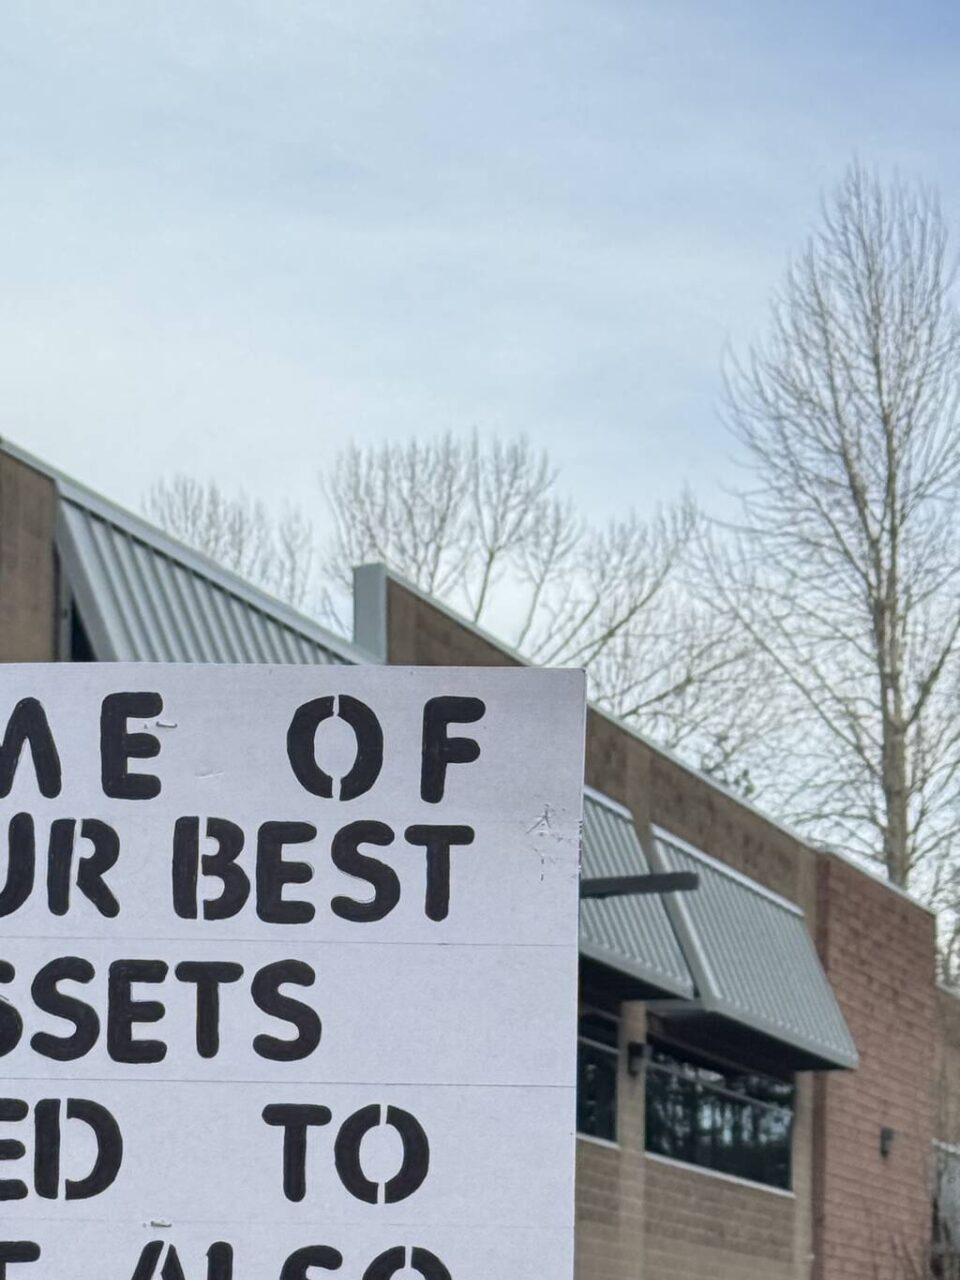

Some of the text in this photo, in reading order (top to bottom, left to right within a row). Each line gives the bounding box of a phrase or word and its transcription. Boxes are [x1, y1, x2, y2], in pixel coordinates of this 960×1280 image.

[286, 694, 487, 804] OF
[171, 815, 475, 925] BEST
[261, 1103, 430, 1205] TO
